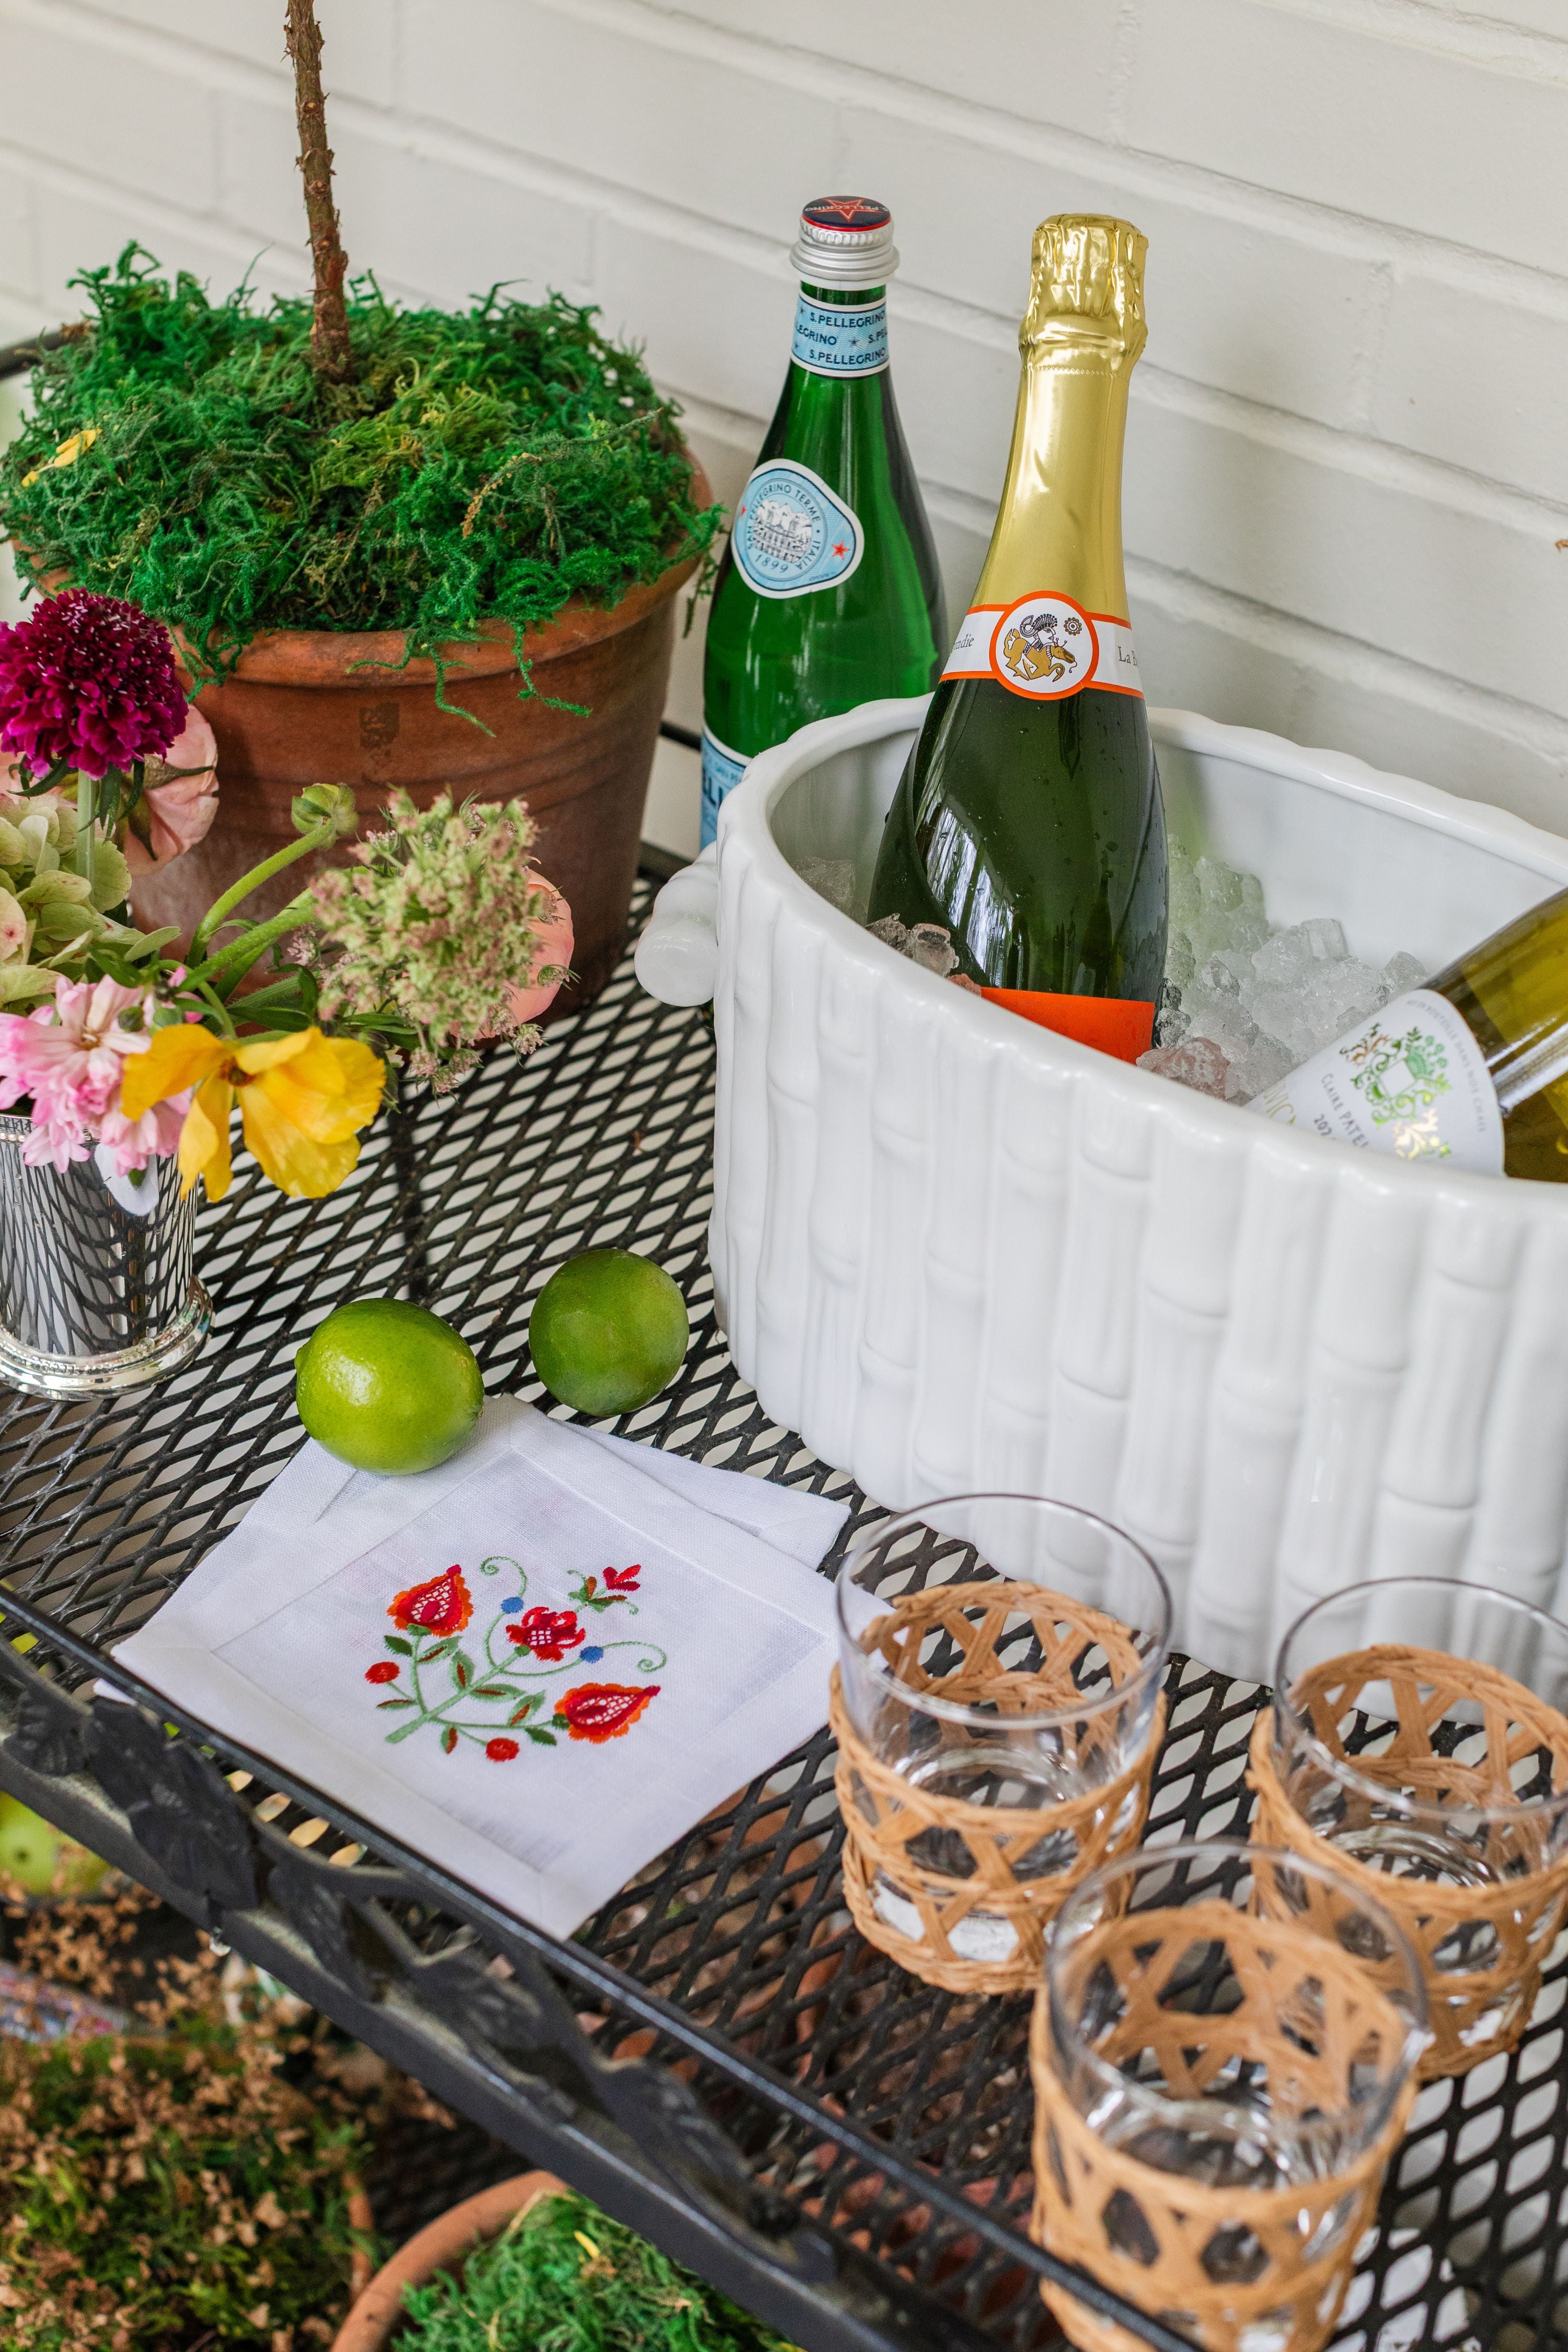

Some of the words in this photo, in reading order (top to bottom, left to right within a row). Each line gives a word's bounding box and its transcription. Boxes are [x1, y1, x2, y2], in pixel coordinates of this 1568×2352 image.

[810, 310, 885, 328] S.PELLEGRINO
[810, 347, 885, 364] S.PELLEGRINO
[795, 490, 821, 522] TERME
[754, 555, 789, 573] 1899
[795, 540, 821, 570] ITALIA
[1117, 646, 1131, 664] La
[1313, 1113, 1336, 1140] 202
